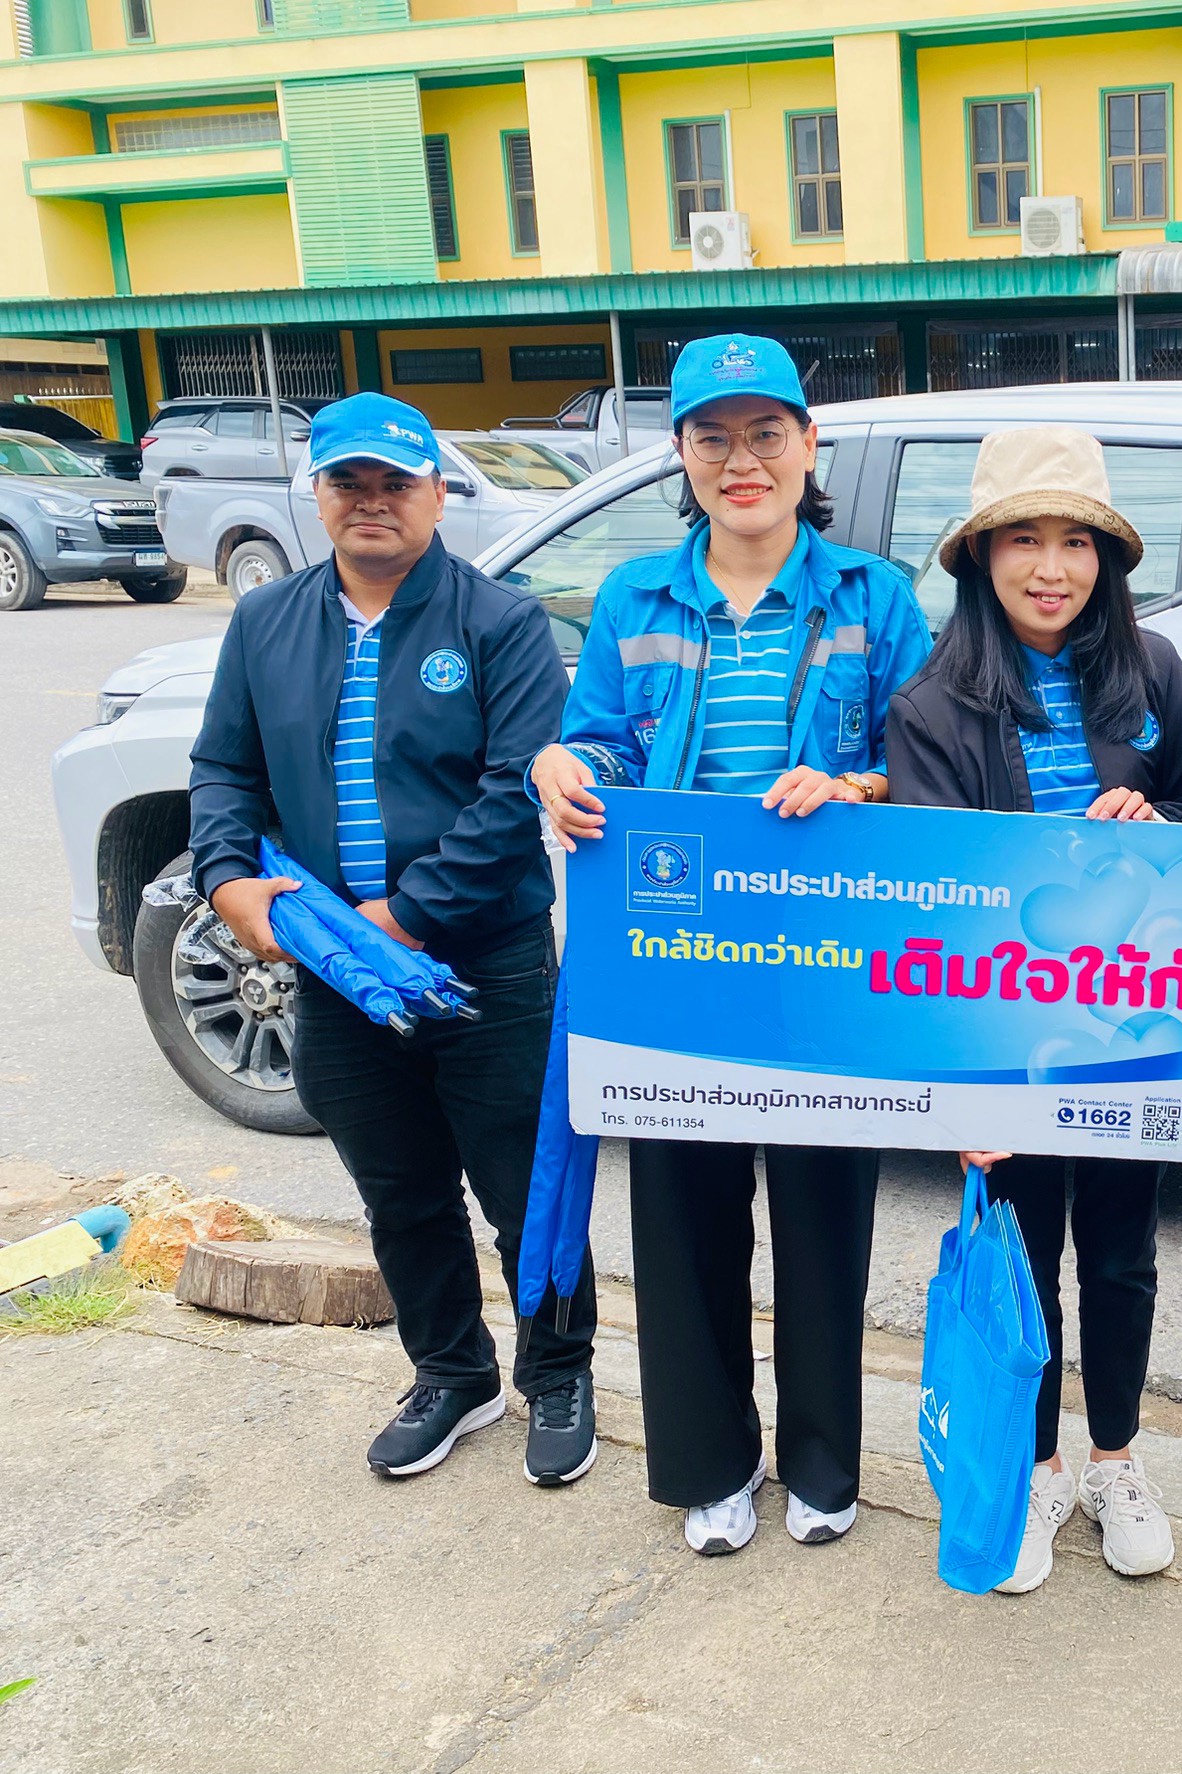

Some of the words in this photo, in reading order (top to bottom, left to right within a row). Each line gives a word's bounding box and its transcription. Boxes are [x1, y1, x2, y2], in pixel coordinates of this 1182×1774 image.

[713, 868, 1011, 911] การประปาส่วนภูมิภาค
[627, 928, 864, 969] ใกล้ชิดกว่าเดิม
[602, 1083, 932, 1113] การประปาส่วนภูมิภาคสาขากระบี่
[1058, 1097, 1076, 1105] PWA
[1078, 1099, 1107, 1107] Contact
[1108, 1100, 1133, 1108] Center
[1144, 1096, 1182, 1104] Application
[601, 1112, 629, 1126] โทร.
[634, 1114, 705, 1129] 075-611354
[1078, 1107, 1132, 1127] 1662
